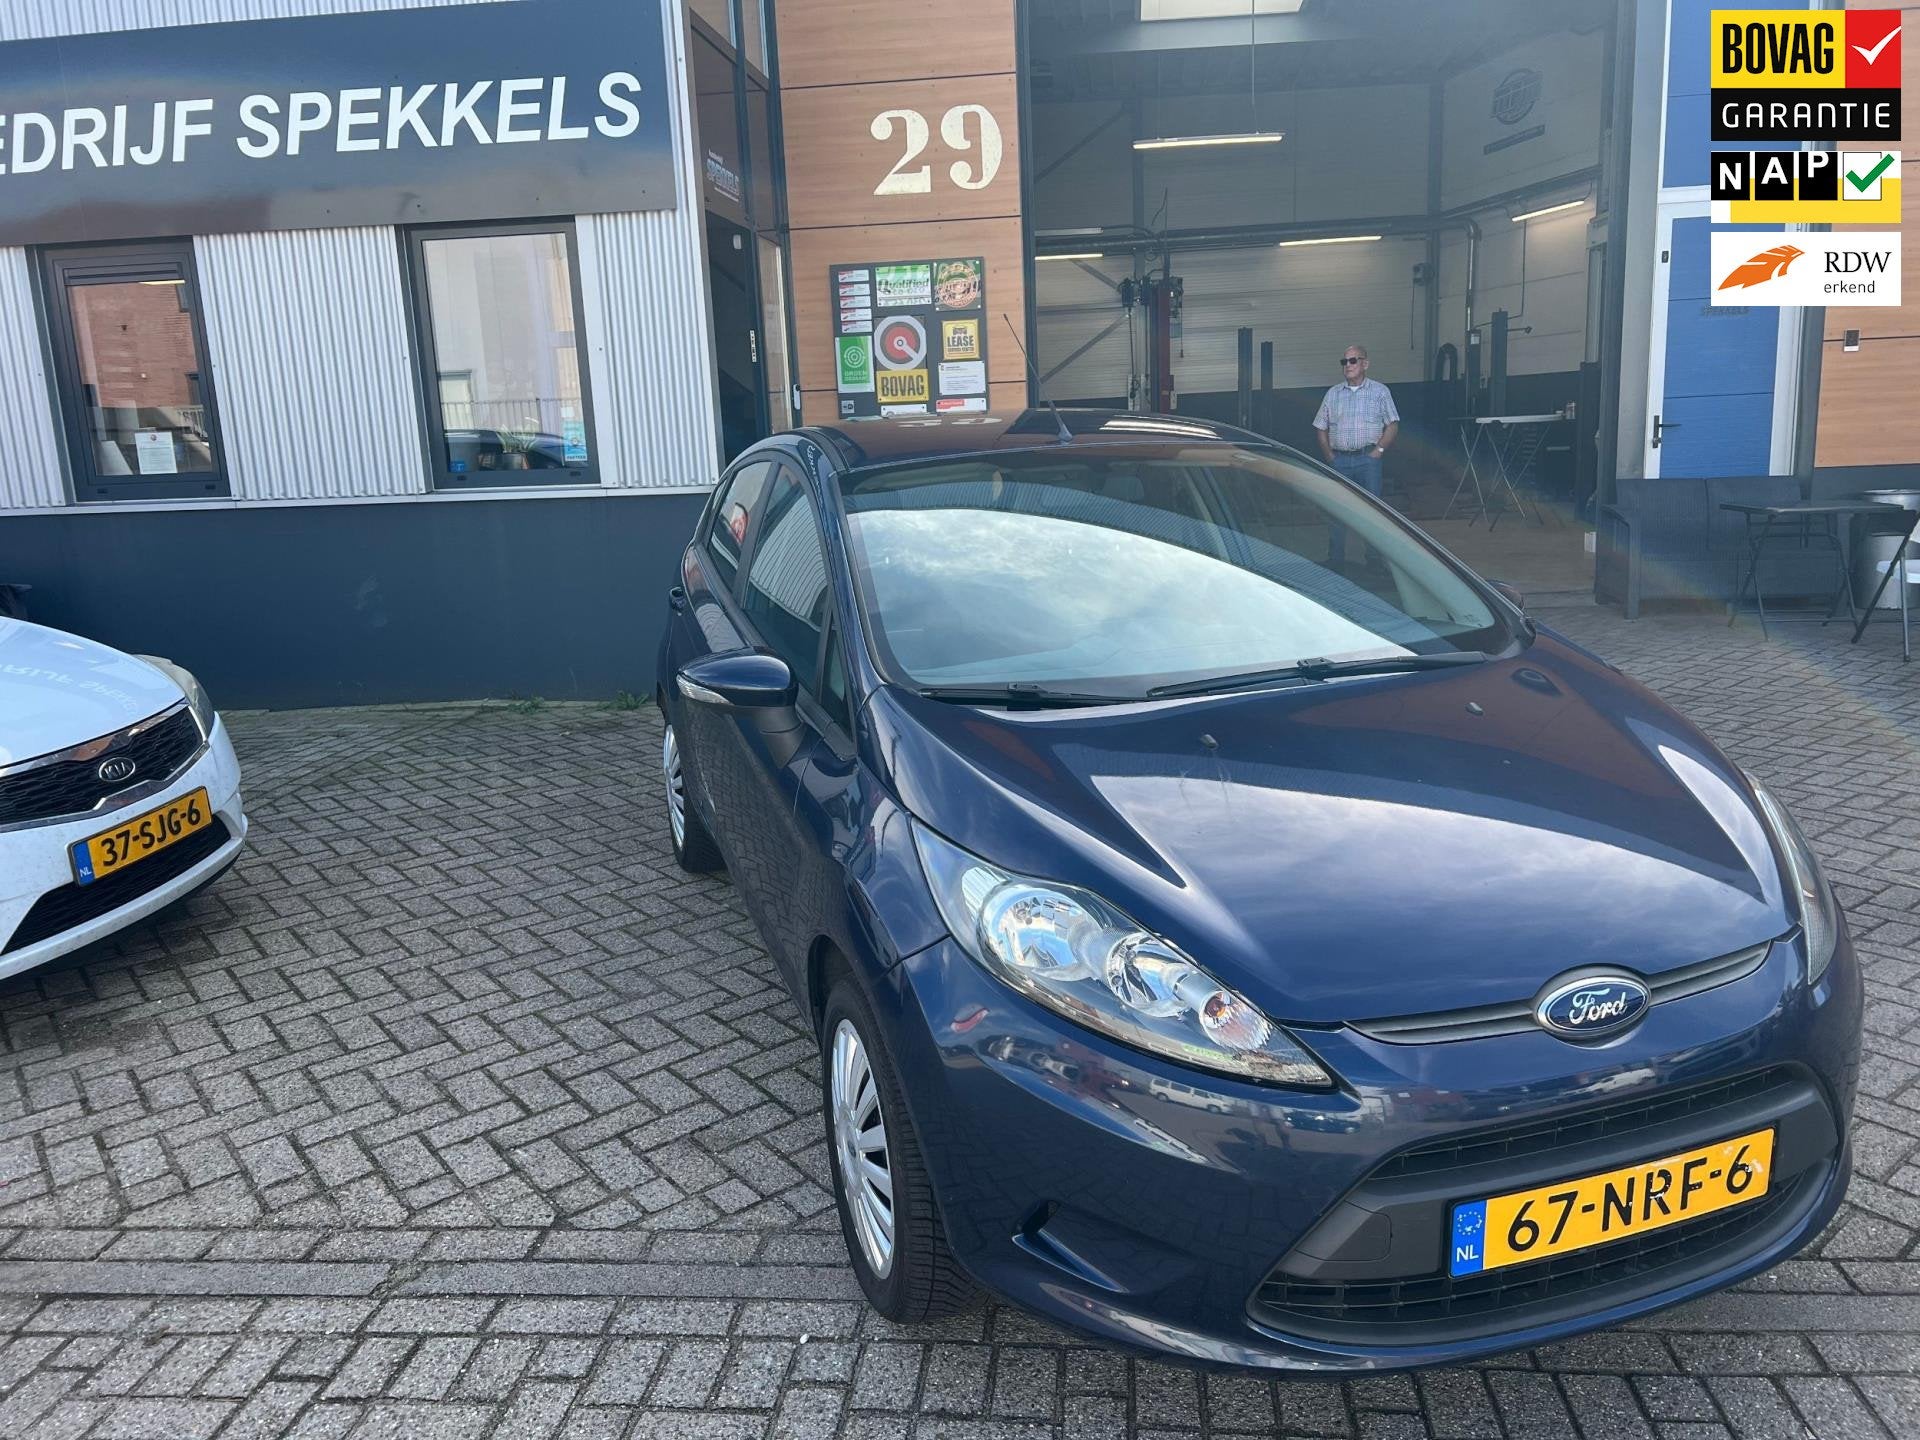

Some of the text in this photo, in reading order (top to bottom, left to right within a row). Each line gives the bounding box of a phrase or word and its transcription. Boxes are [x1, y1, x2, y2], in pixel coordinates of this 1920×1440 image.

[0, 71, 642, 175] DRIJF SPEKKELS
[870, 104, 1003, 196] 29
[947, 335, 975, 348] LEASE
[880, 374, 925, 397] BOVAG
[103, 761, 128, 779] KIA
[101, 798, 201, 867] 37-SJG-6
[79, 866, 93, 877] NL
[1568, 988, 1628, 1025] Ford
[1507, 1144, 1755, 1253] 67-NRF-6
[1456, 1244, 1480, 1263] NL
